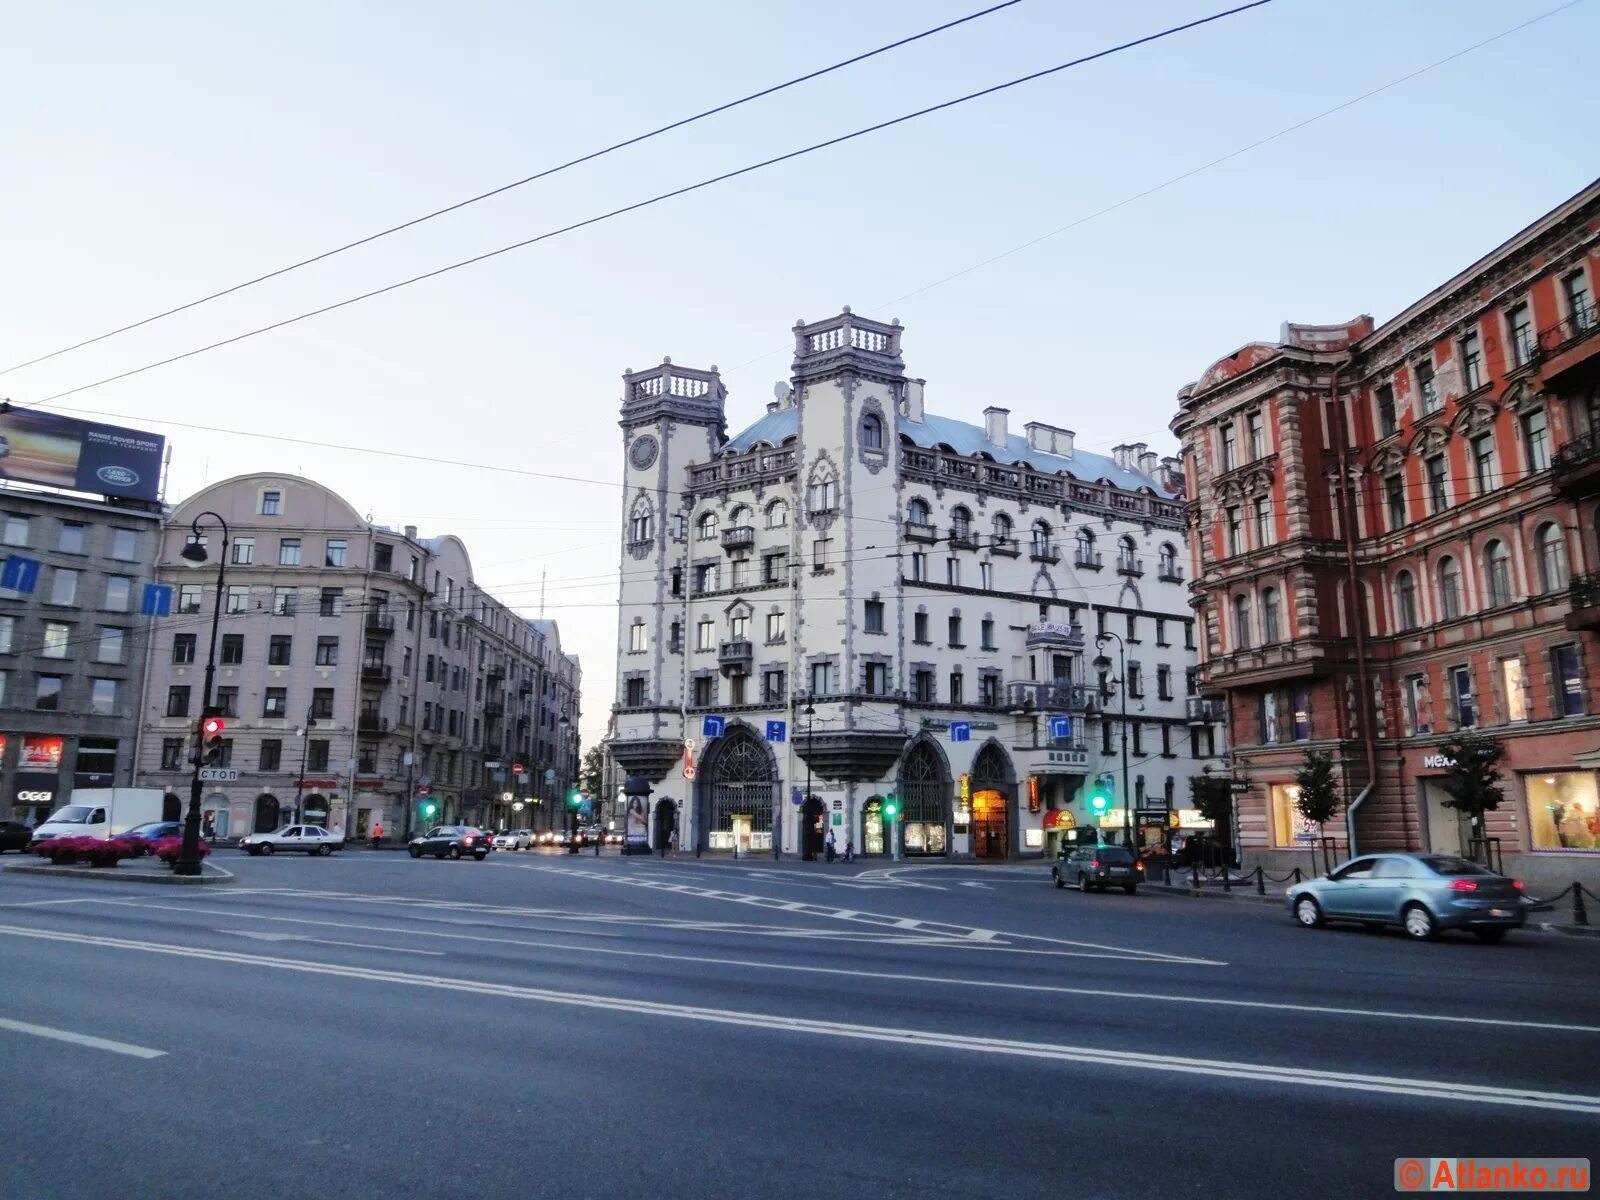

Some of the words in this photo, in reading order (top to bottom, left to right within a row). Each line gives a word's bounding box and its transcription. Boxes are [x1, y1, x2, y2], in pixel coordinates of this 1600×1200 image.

[88, 431, 112, 441] RANGE
[112, 436, 135, 445] ROVER
[136, 440, 158, 449] SPORT
[25, 745, 60, 757] SALE
[201, 770, 236, 780] СТОП
[17, 790, 53, 801] OGGI
